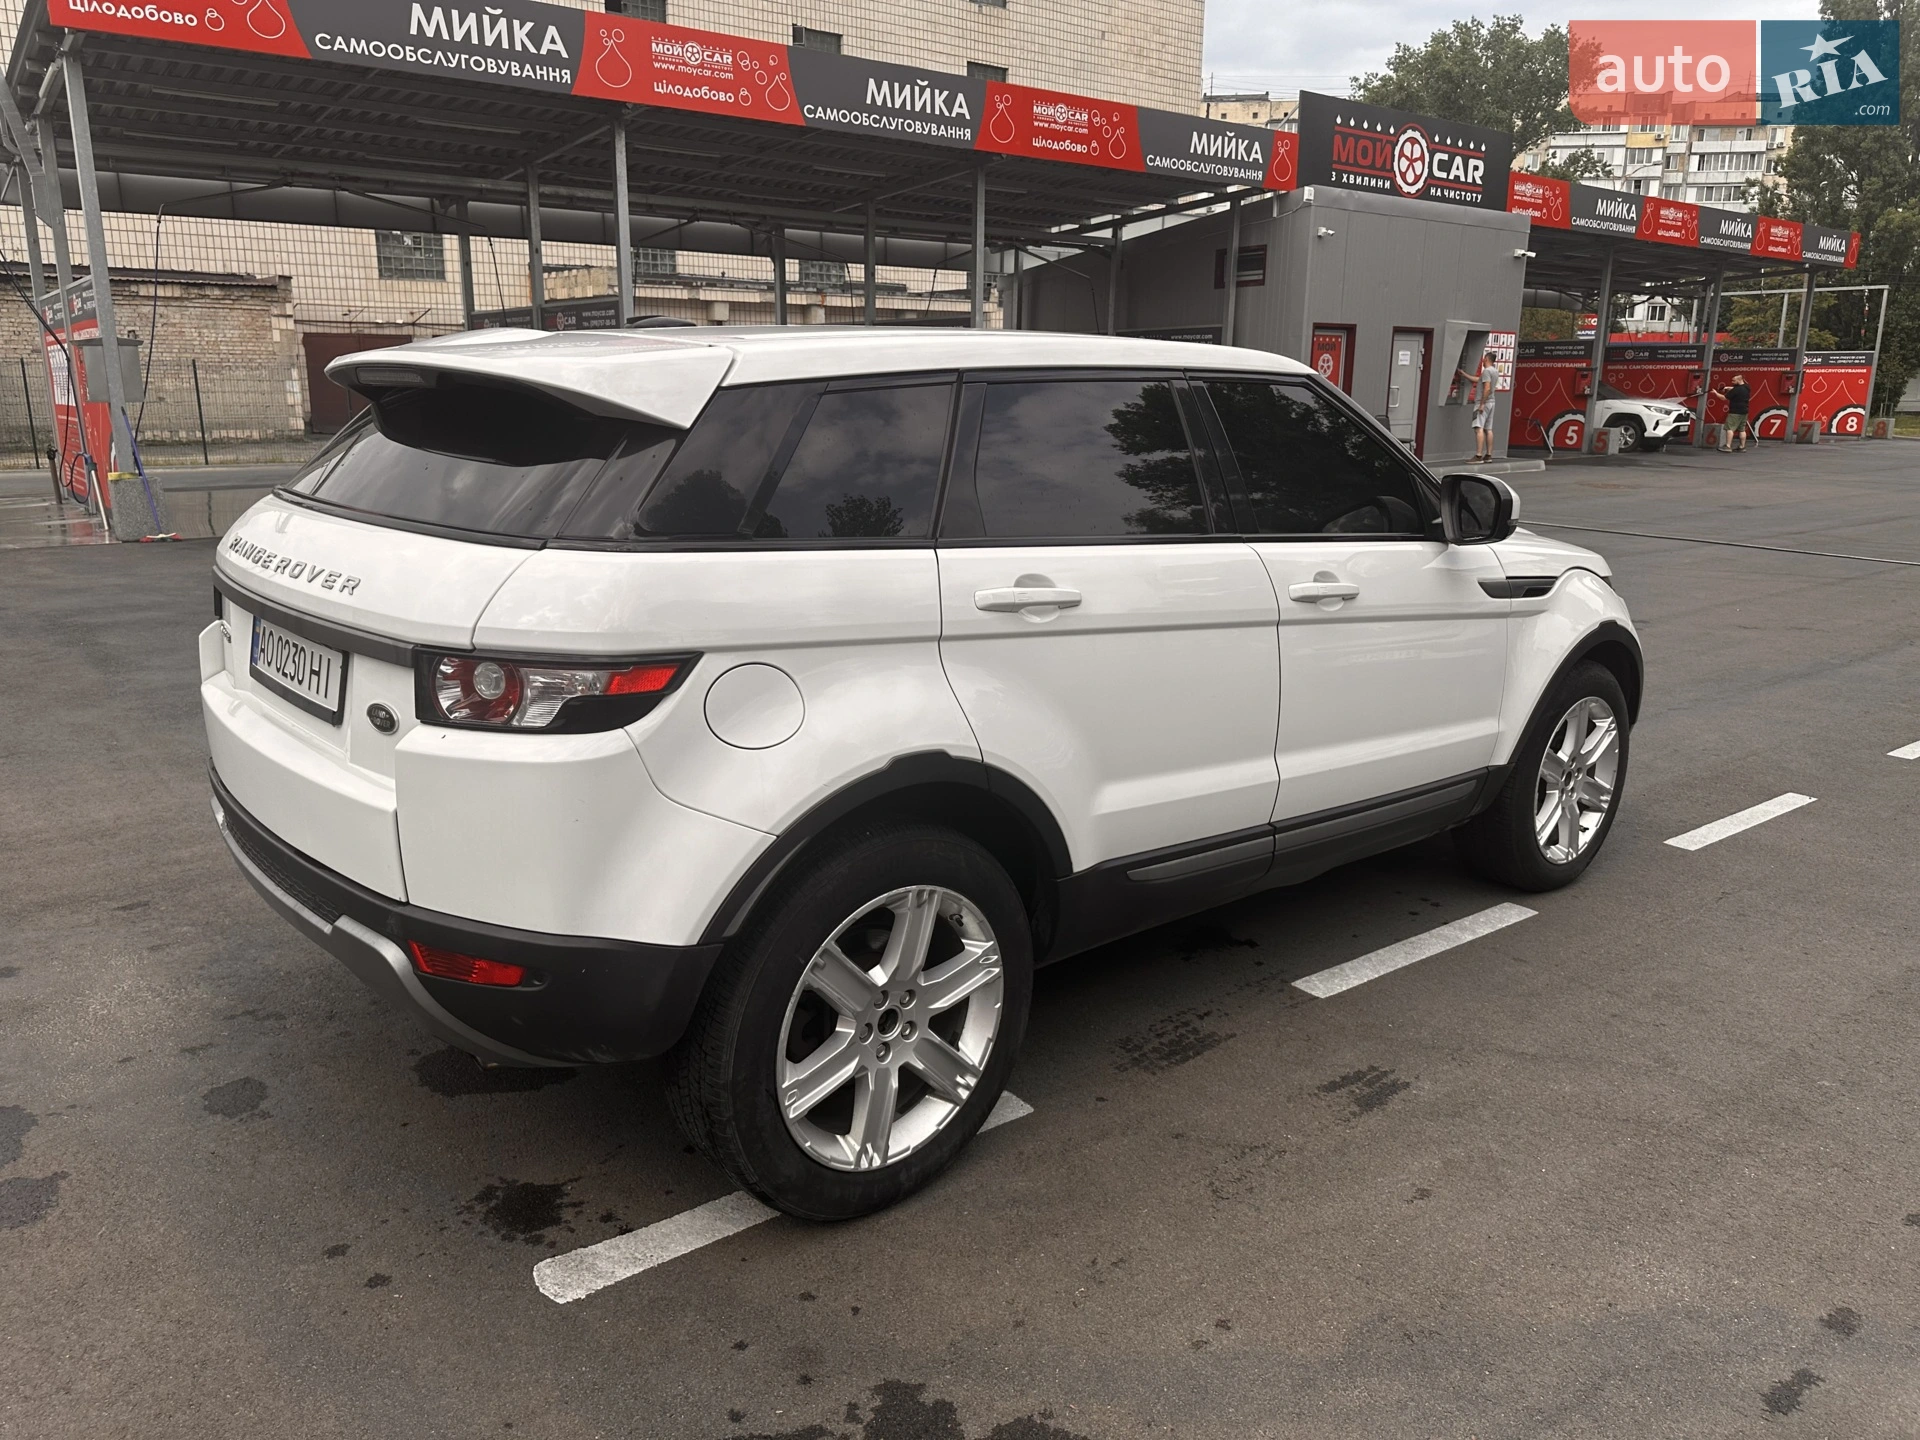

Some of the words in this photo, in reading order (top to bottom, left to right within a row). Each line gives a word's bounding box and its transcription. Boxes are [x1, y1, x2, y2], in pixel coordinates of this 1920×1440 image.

[68, 0, 198, 27] цілодобово
[408, 2, 570, 59] МИЙКА
[314, 32, 573, 85] САМООБСЛУГОВУВАННЯ
[651, 42, 683, 57] МОЙ
[703, 51, 733, 65] CAR
[653, 61, 734, 80] www.moycar.com
[653, 79, 735, 103] цілодобово
[865, 77, 971, 120] МИЙКА
[803, 104, 972, 142] САМООБСЛУГОВУВАННЯ
[1033, 105, 1055, 116] МОЙ
[1068, 111, 1088, 122] CAR
[1033, 120, 1089, 135] www.moycar.com
[1032, 135, 1088, 153] цілодобово
[1189, 130, 1264, 165] МИЙКА
[1146, 154, 1264, 182] САМООБСЛУГОВУВАННЯ
[1332, 134, 1392, 170] МОЙ
[1432, 152, 1485, 185] CAR
[1331, 171, 1337, 182] З
[1342, 173, 1391, 190] ХВИЛИНИ
[1430, 186, 1442, 197] НА
[1443, 189, 1483, 203] ЧИСТОТУ
[1595, 197, 1637, 221] МИЙКА
[1571, 216, 1636, 234] САМООБСЛУГОВУВАННЯ
[1719, 218, 1753, 239] МИЙКА
[1699, 235, 1752, 250] САМООБСЛУГОВУВАННЯ
[1818, 234, 1846, 253] МИЙКА
[1170, 333, 1213, 341] www.moycar.com
[1769, 419, 1782, 435] 7
[1800, 423, 1814, 441] 7
[1846, 416, 1858, 432] 8
[1875, 420, 1888, 437] 8
[1564, 425, 1579, 445] 5
[1592, 431, 1609, 453] 5
[1705, 428, 1718, 445] 6
[276, 636, 307, 686] 0230
